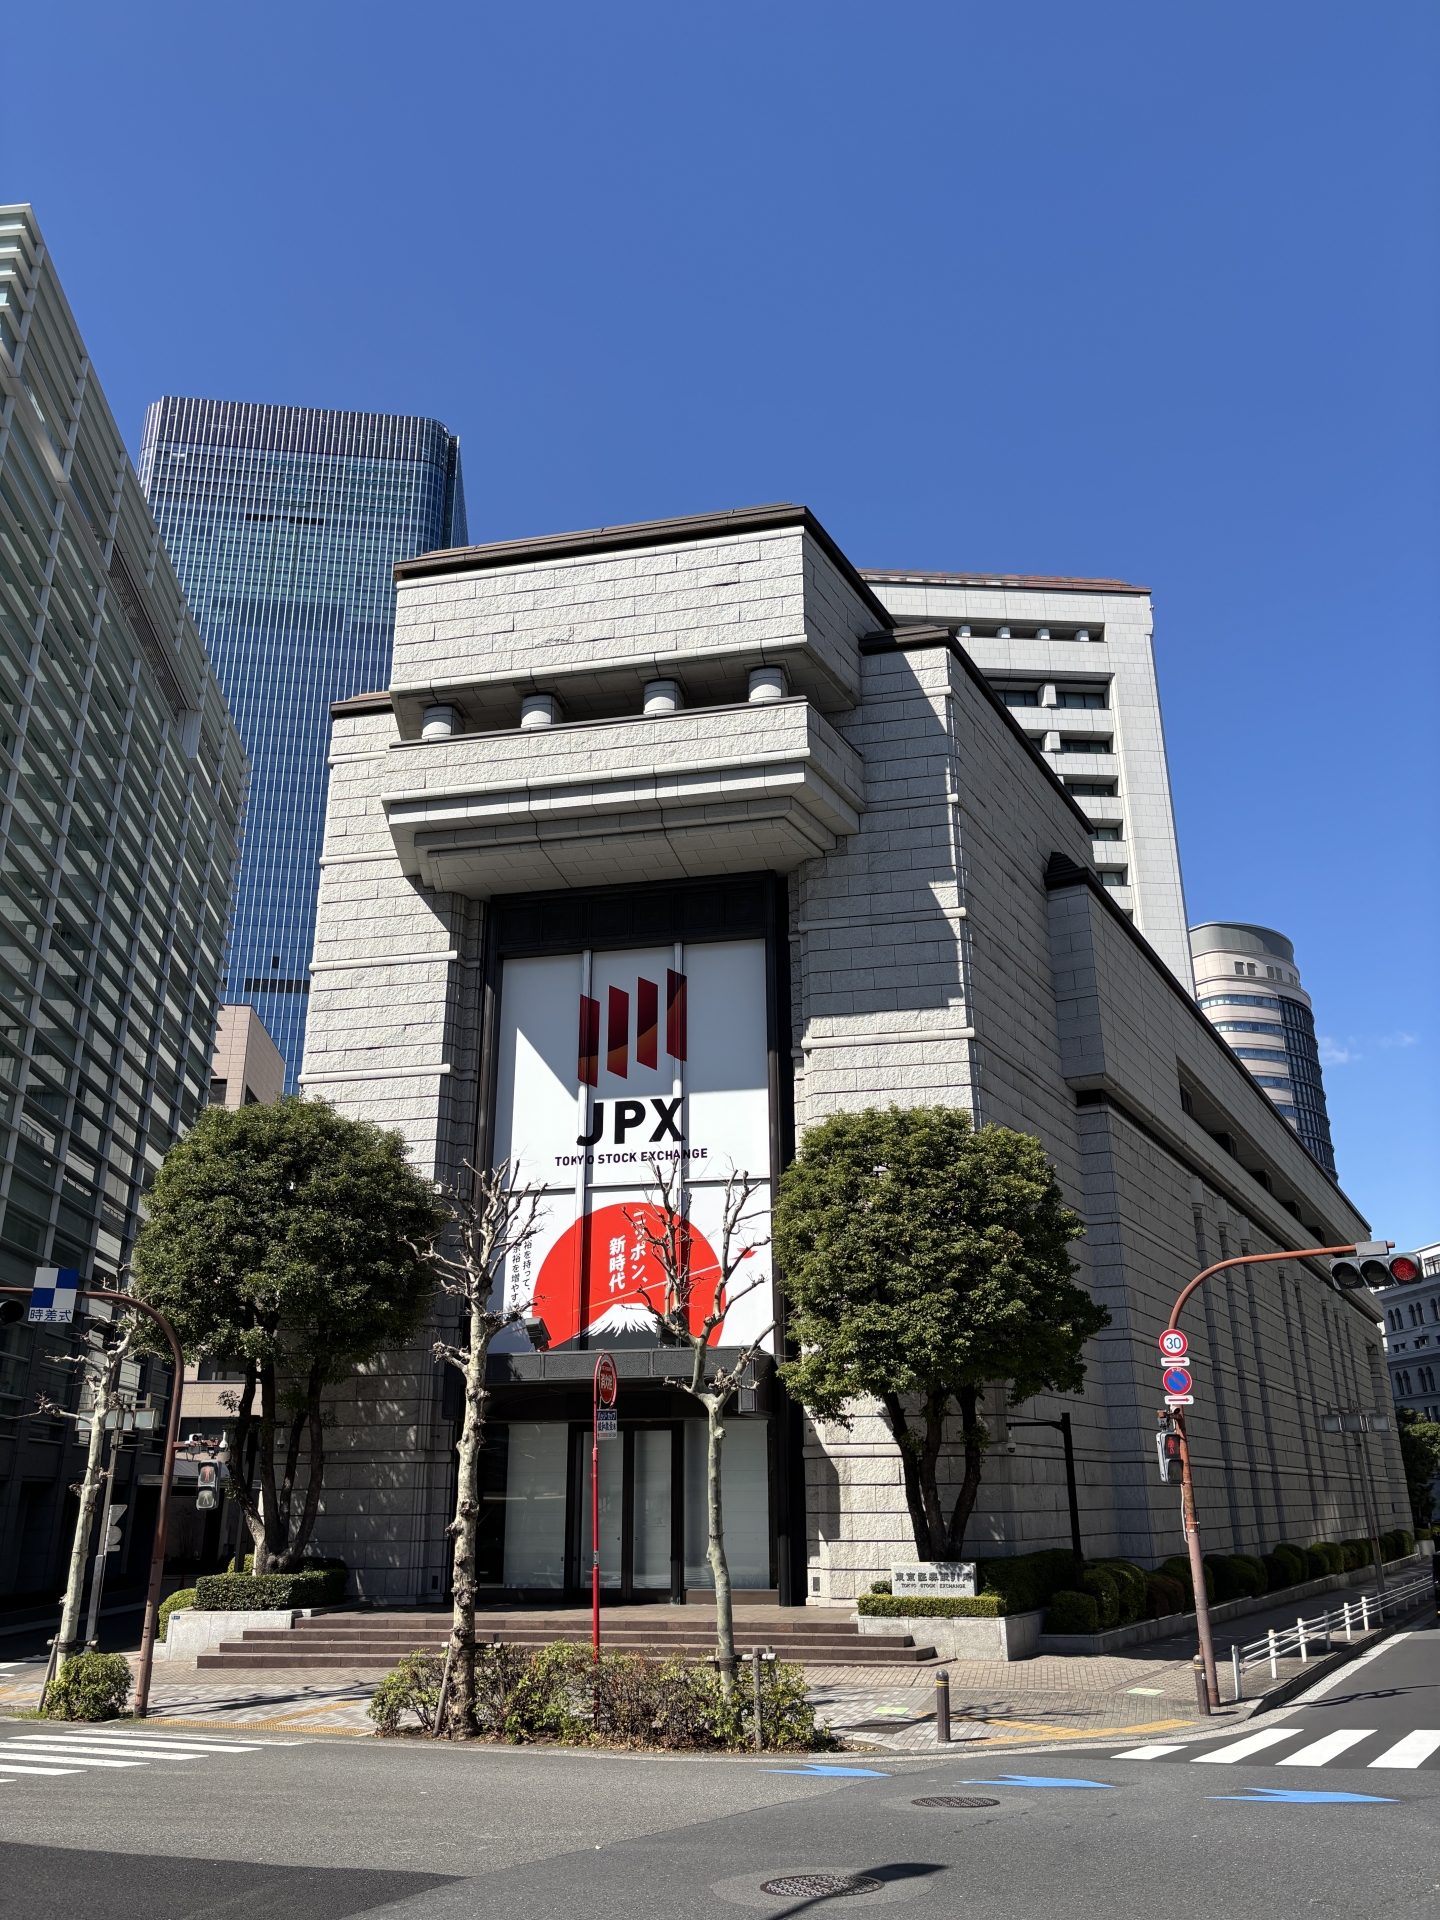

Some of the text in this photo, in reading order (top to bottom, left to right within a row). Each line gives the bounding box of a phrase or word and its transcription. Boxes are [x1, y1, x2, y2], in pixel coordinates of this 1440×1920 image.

[576, 1097, 687, 1147] JPX
[555, 1148, 708, 1167] TOKYO STOCK EXCHANGE
[522, 1234, 533, 1291] 裕を持って、
[608, 1234, 626, 1293] 新時代
[30, 1309, 72, 1322] 時差式
[1166, 1337, 1181, 1349] 30
